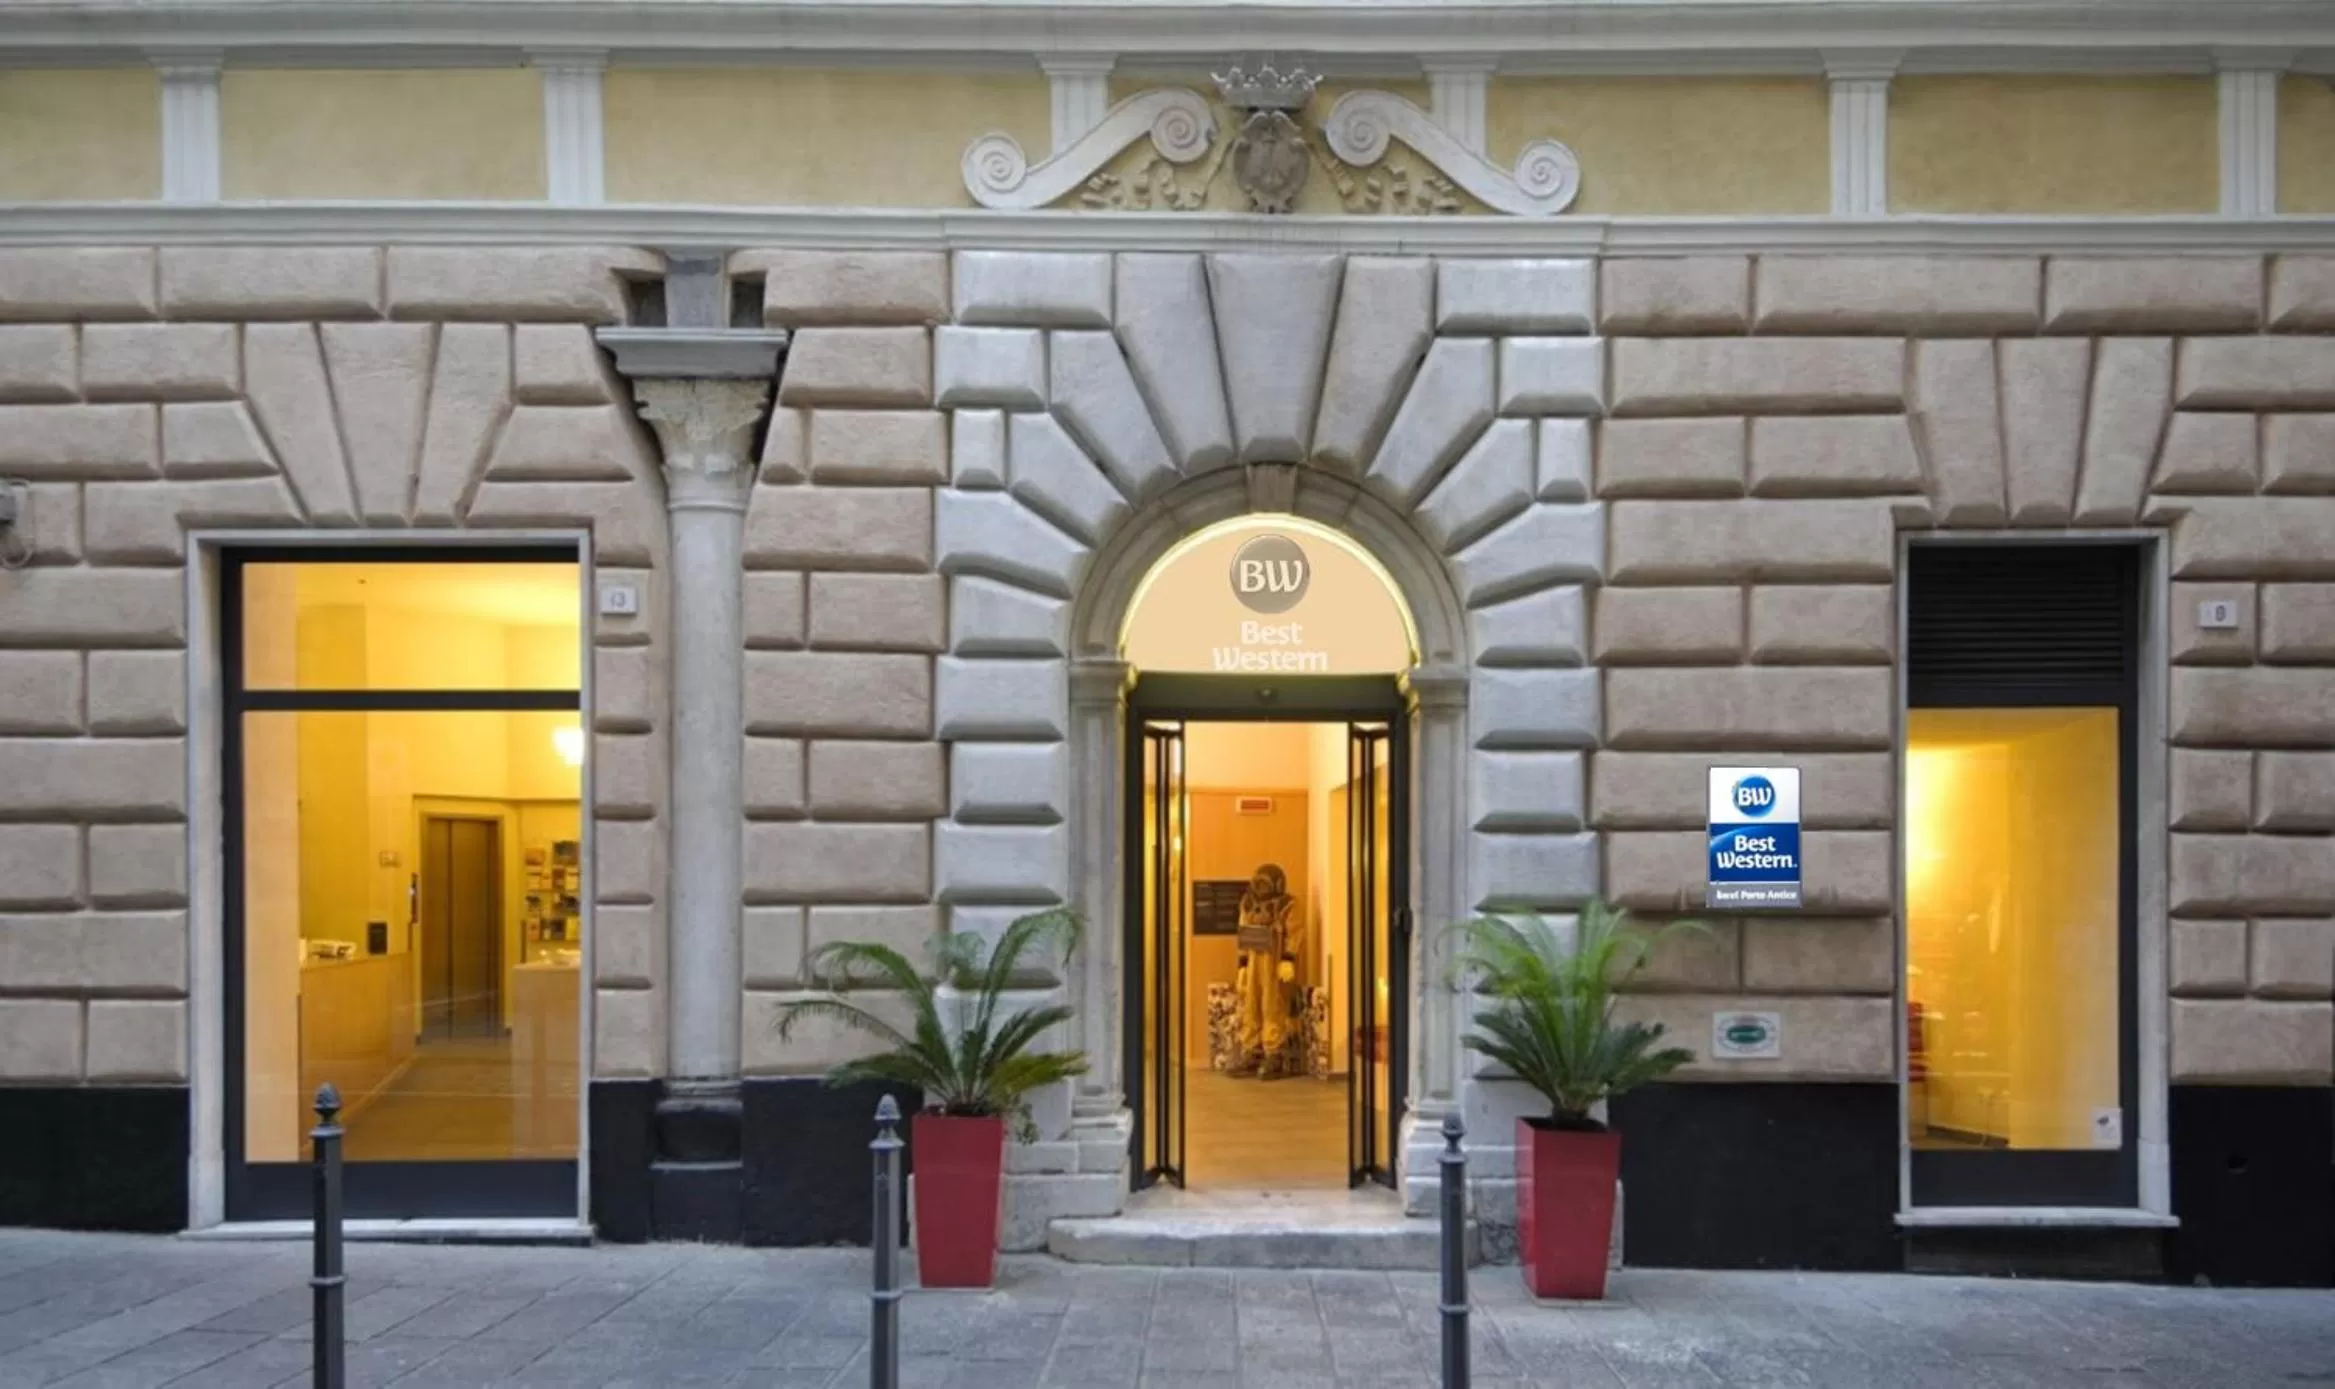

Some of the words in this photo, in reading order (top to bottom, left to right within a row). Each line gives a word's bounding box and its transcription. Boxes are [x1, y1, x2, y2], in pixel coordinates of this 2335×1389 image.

[1240, 560, 1303, 592] BW
[1240, 621, 1303, 644] Best
[1212, 647, 1328, 670] Western
[1738, 787, 1771, 806] BW
[1734, 835, 1776, 851] Best
